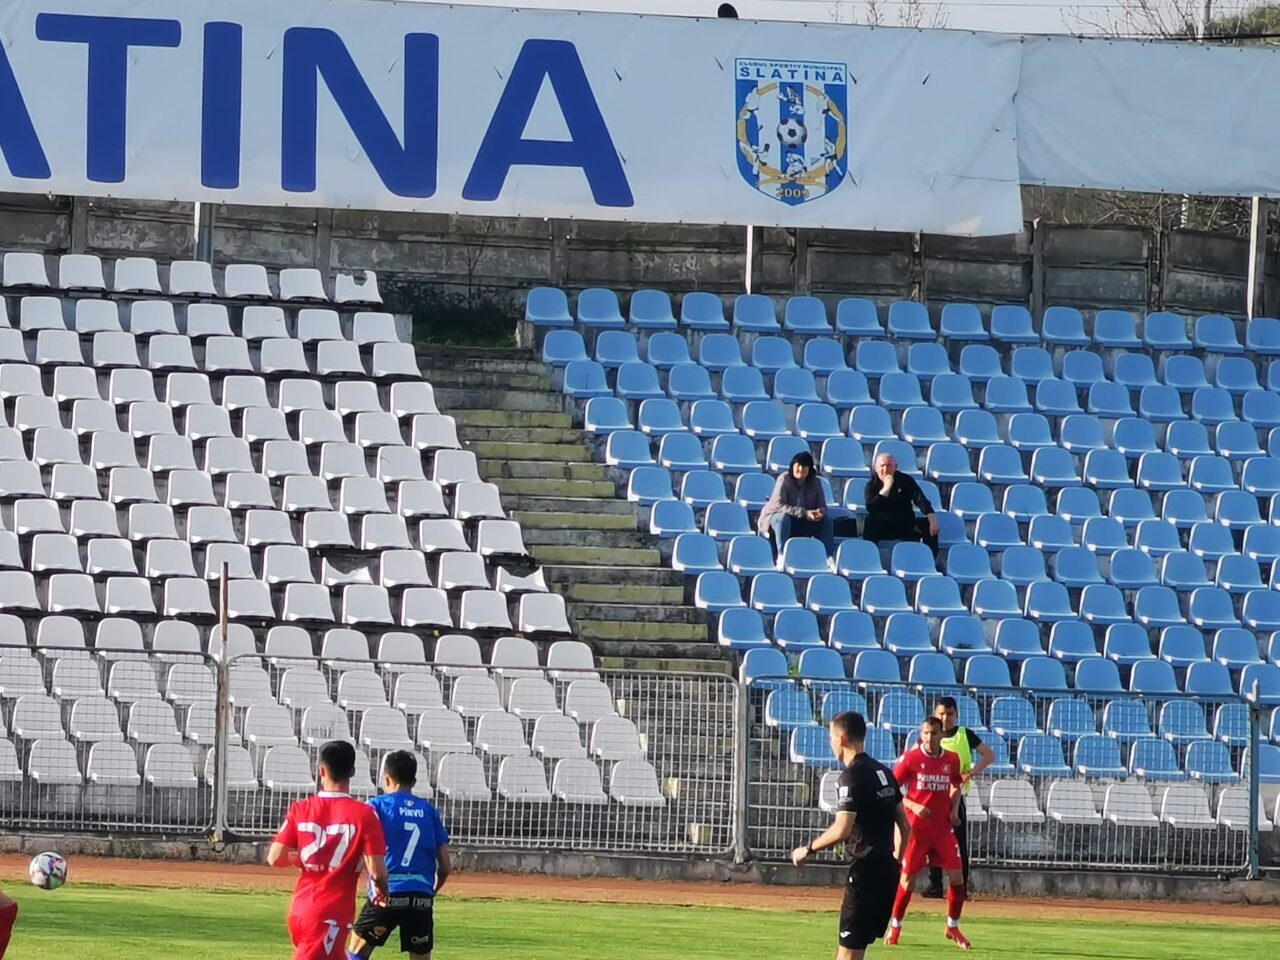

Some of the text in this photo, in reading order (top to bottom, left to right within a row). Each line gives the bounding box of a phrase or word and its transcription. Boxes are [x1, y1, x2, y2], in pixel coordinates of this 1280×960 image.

[740, 67, 844, 82] SLATINA
[297, 821, 356, 872] 27
[401, 821, 421, 867] 7
